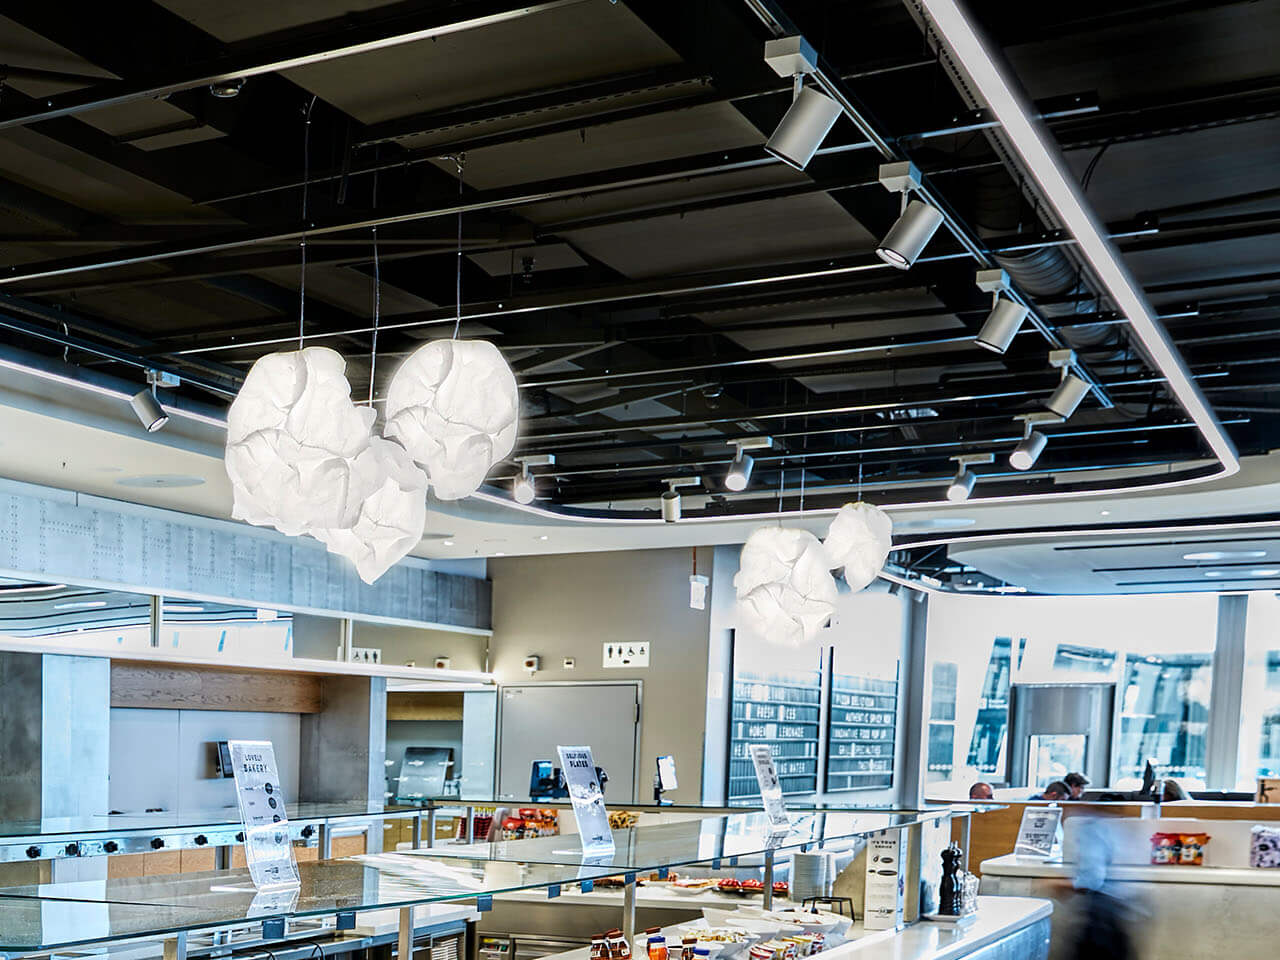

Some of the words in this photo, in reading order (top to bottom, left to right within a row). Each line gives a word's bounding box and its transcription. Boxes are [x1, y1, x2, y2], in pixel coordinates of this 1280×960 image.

[244, 754, 263, 762] LOVELY
[243, 763, 268, 773] BAKERY
[569, 760, 589, 768] PLATES
